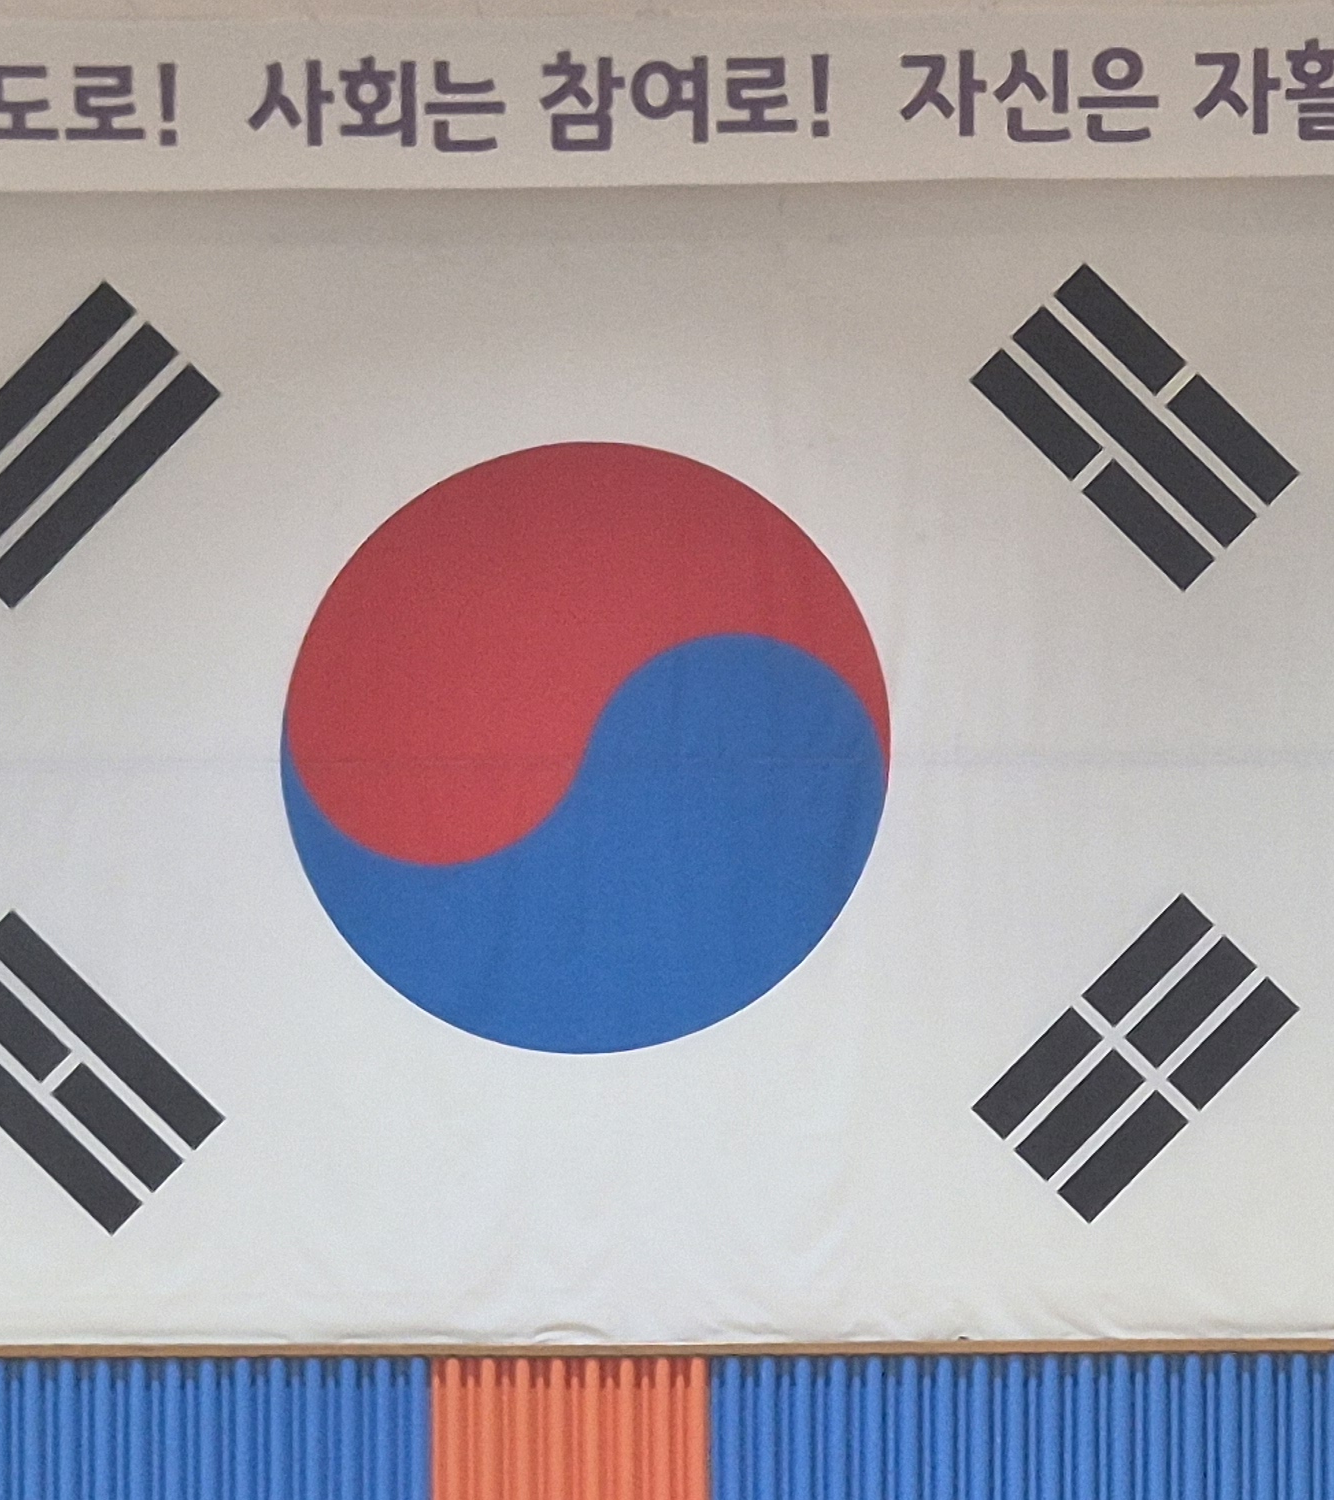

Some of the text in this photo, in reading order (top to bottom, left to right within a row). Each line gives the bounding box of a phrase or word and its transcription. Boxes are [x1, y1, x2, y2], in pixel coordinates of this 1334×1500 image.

[247, 55, 505, 153] 사회는
[538, 50, 832, 153] 참여로!
[898, 45, 1160, 144] 자신은
